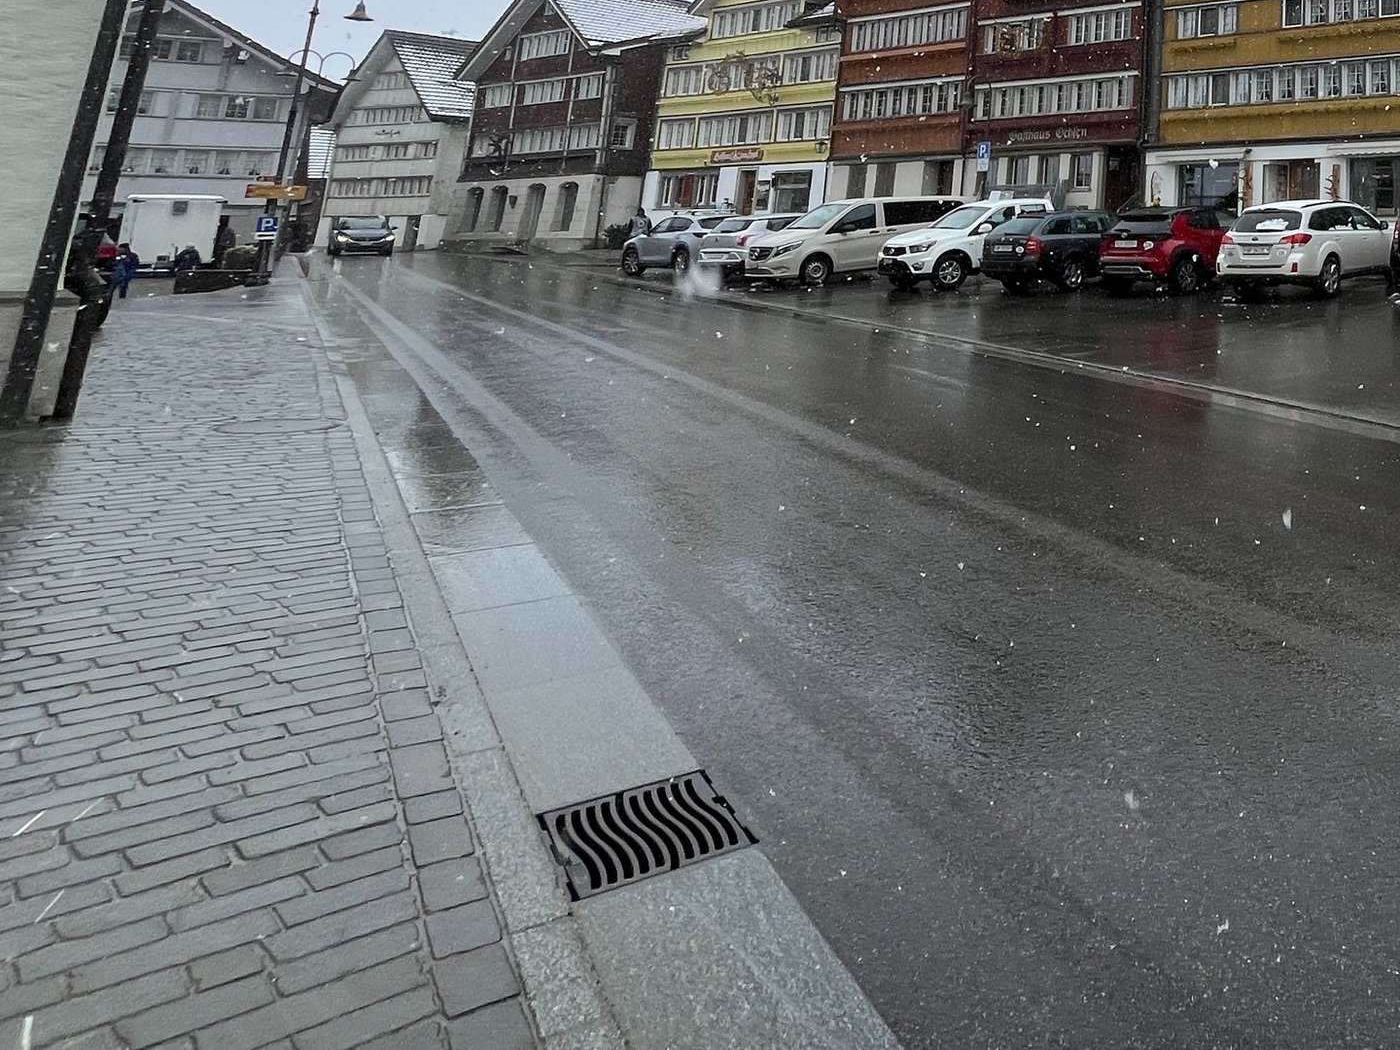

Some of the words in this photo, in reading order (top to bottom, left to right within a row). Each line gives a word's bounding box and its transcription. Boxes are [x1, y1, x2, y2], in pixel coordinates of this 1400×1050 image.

[1008, 131, 1051, 142] Gasthaus
[1055, 127, 1087, 140] Ochsen
[979, 144, 987, 157] P
[261, 218, 274, 231] P
